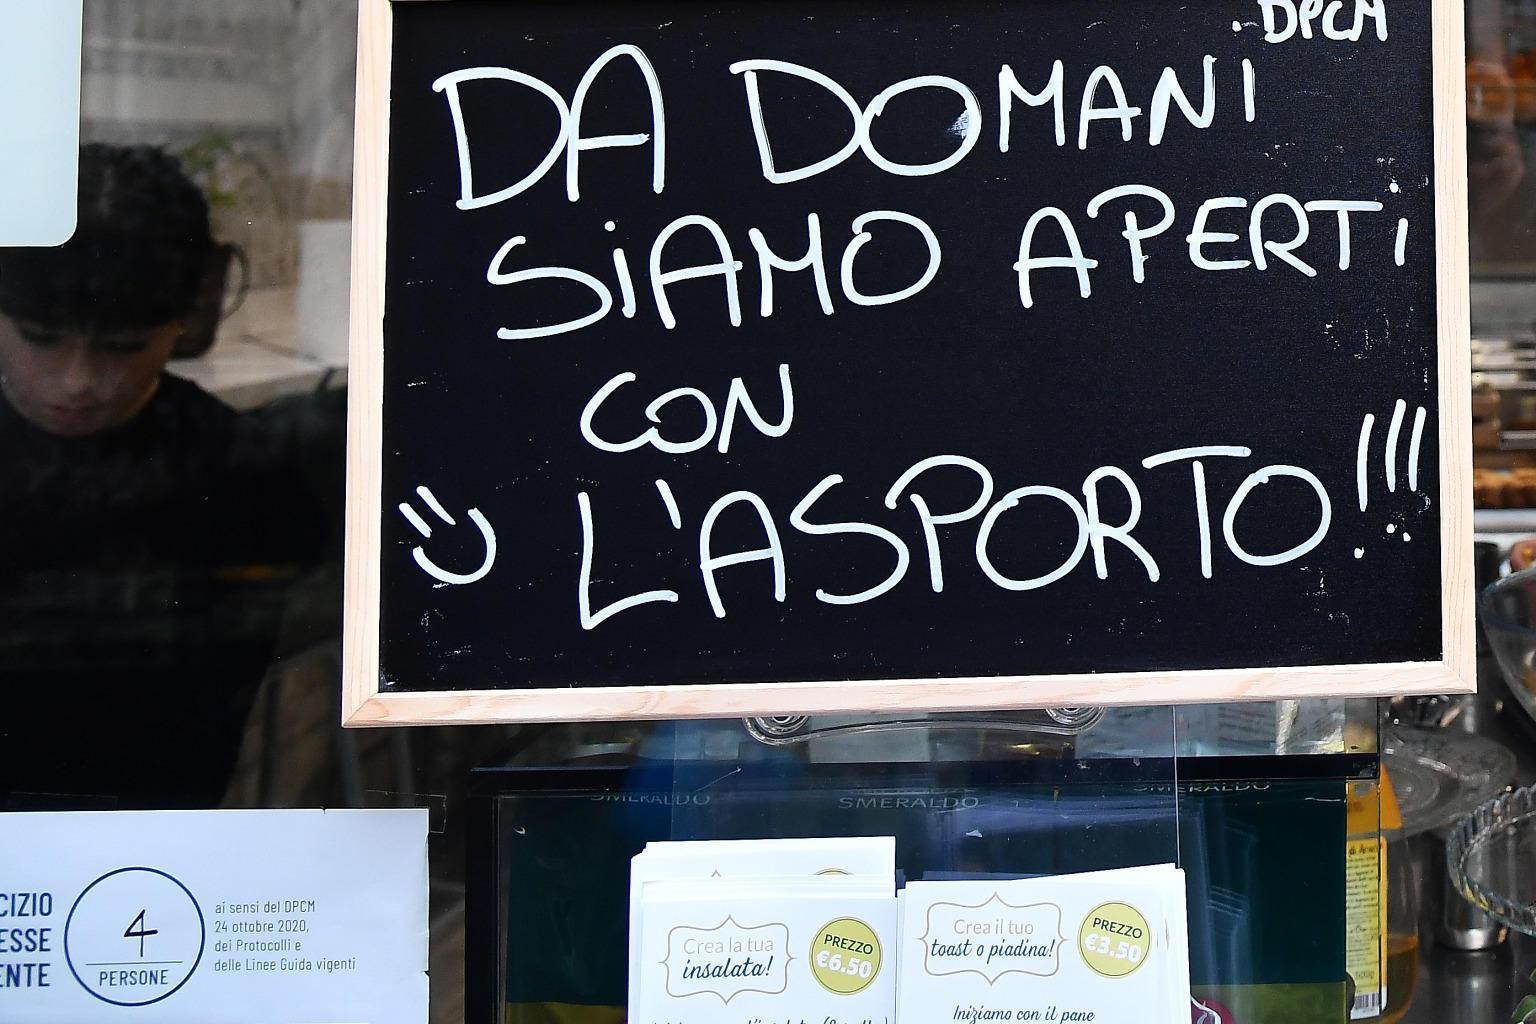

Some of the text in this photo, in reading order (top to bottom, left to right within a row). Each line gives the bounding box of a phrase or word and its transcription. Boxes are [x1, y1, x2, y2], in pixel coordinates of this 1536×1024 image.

[431, 43, 667, 211] DA
[579, 363, 794, 454] CON
[837, 796, 979, 809] SMERALDO
[0, 892, 53, 917] CIZIO
[215, 900, 316, 914] ai sensi del DPCM
[123, 908, 159, 958] 4
[214, 919, 310, 934] 24 ottobre 2020,
[953, 918, 1035, 935] Crea il tuo
[1092, 917, 1143, 940] PREZZO
[0, 928, 52, 953] ESSE
[214, 939, 302, 952] dei Protocolli e
[683, 936, 774, 955] Crea la tua
[824, 933, 874, 956] PREZZO
[931, 938, 1056, 965] toast o piadina!
[1084, 933, 1142, 963] €3.50
[214, 957, 356, 974] delle Linee Guida vigenti
[682, 955, 775, 980] insalata!
[815, 950, 873, 979] €6.50
[99, 969, 169, 986] PERSONE
[953, 1005, 1096, 1024] Iniziamo con il pane
